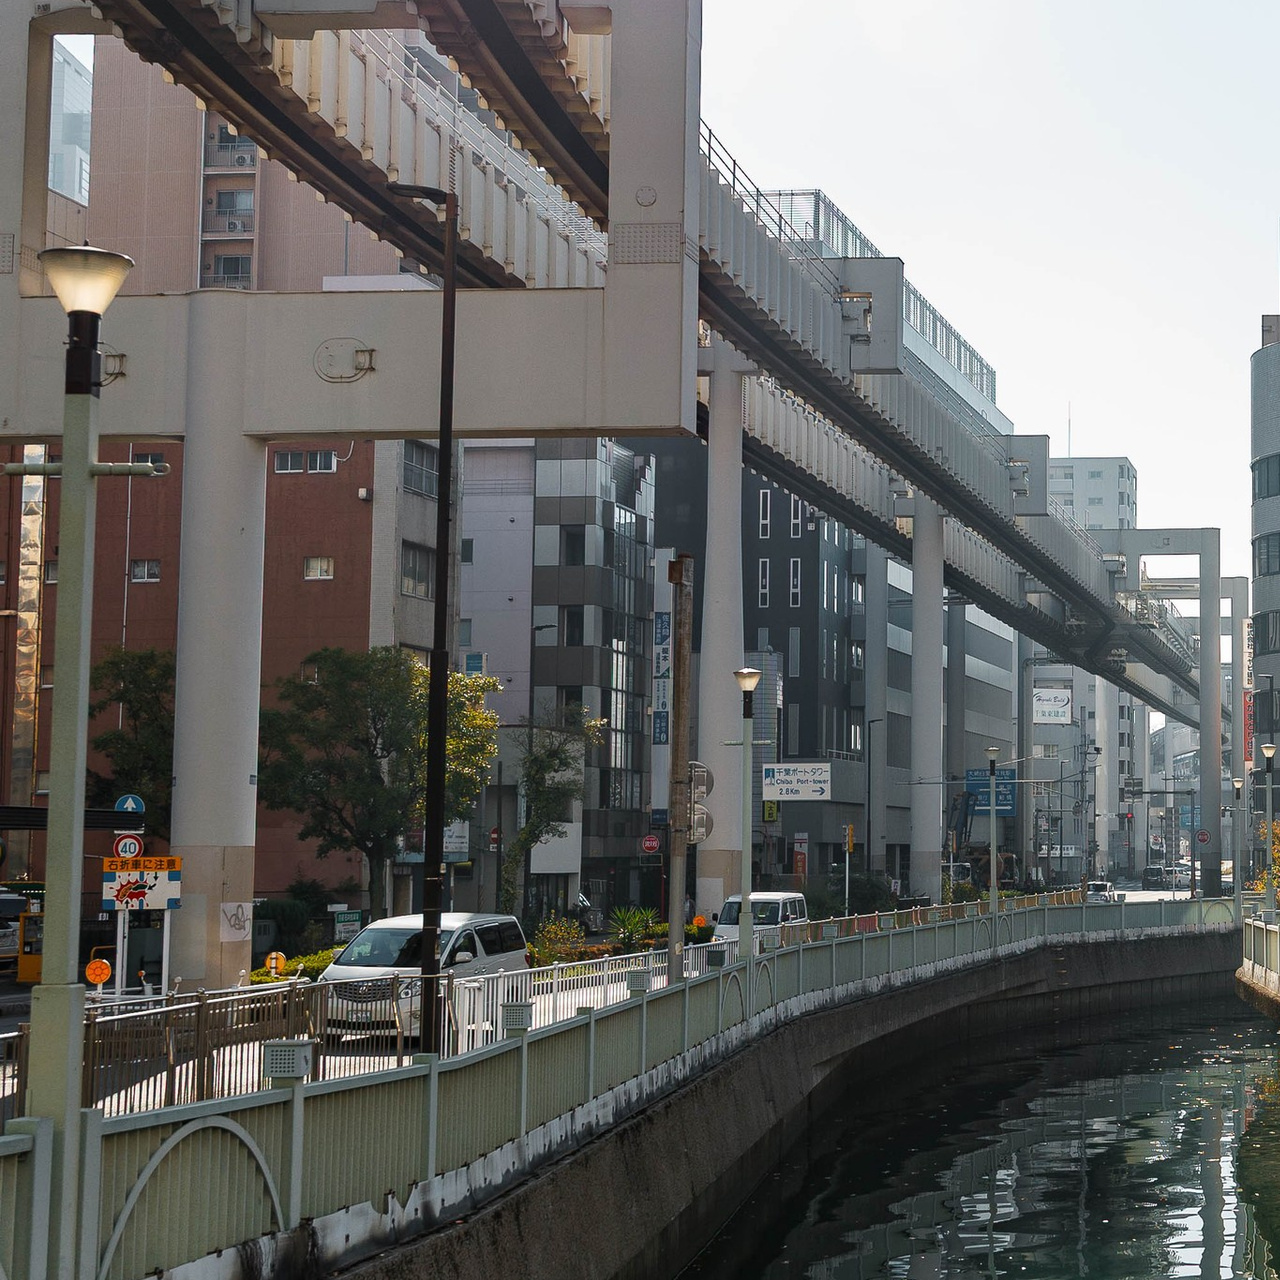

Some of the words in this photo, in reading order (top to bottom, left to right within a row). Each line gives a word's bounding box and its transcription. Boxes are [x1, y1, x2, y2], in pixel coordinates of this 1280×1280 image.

[776, 768, 829, 776] 千葉ポートタワー
[120, 842, 136, 854] 40
[108, 860, 176, 870] 右折車に注意
